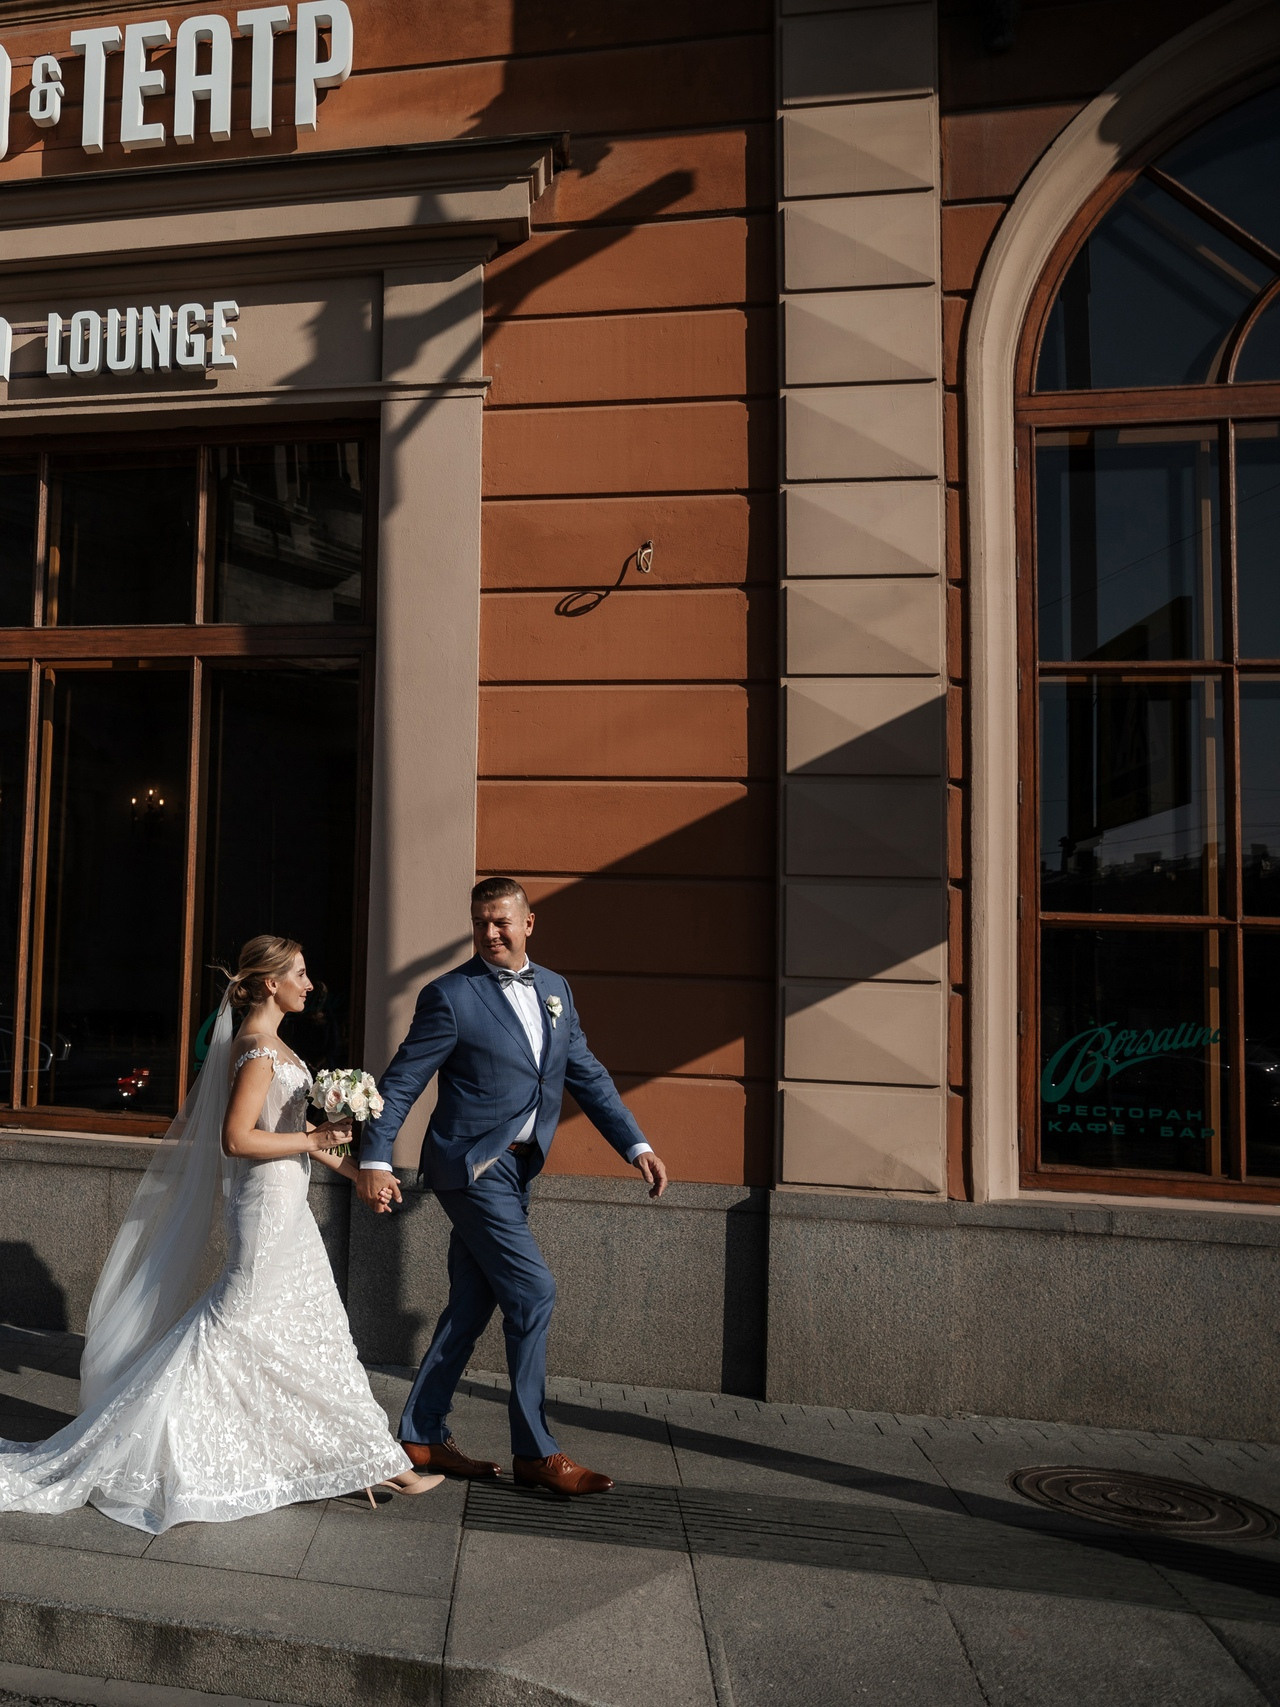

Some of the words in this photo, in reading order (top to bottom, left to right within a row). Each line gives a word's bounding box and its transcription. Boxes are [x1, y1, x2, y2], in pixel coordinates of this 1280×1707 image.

[29, 55, 65, 128] &
[70, 0, 354, 154] ТЕАТР
[46, 300, 240, 379] LOUNGE
[1048, 1121, 1126, 1135] КАФЕ
[1160, 1126, 1216, 1138] БАР
[1057, 1104, 1202, 1121] РЕСТОРАН
